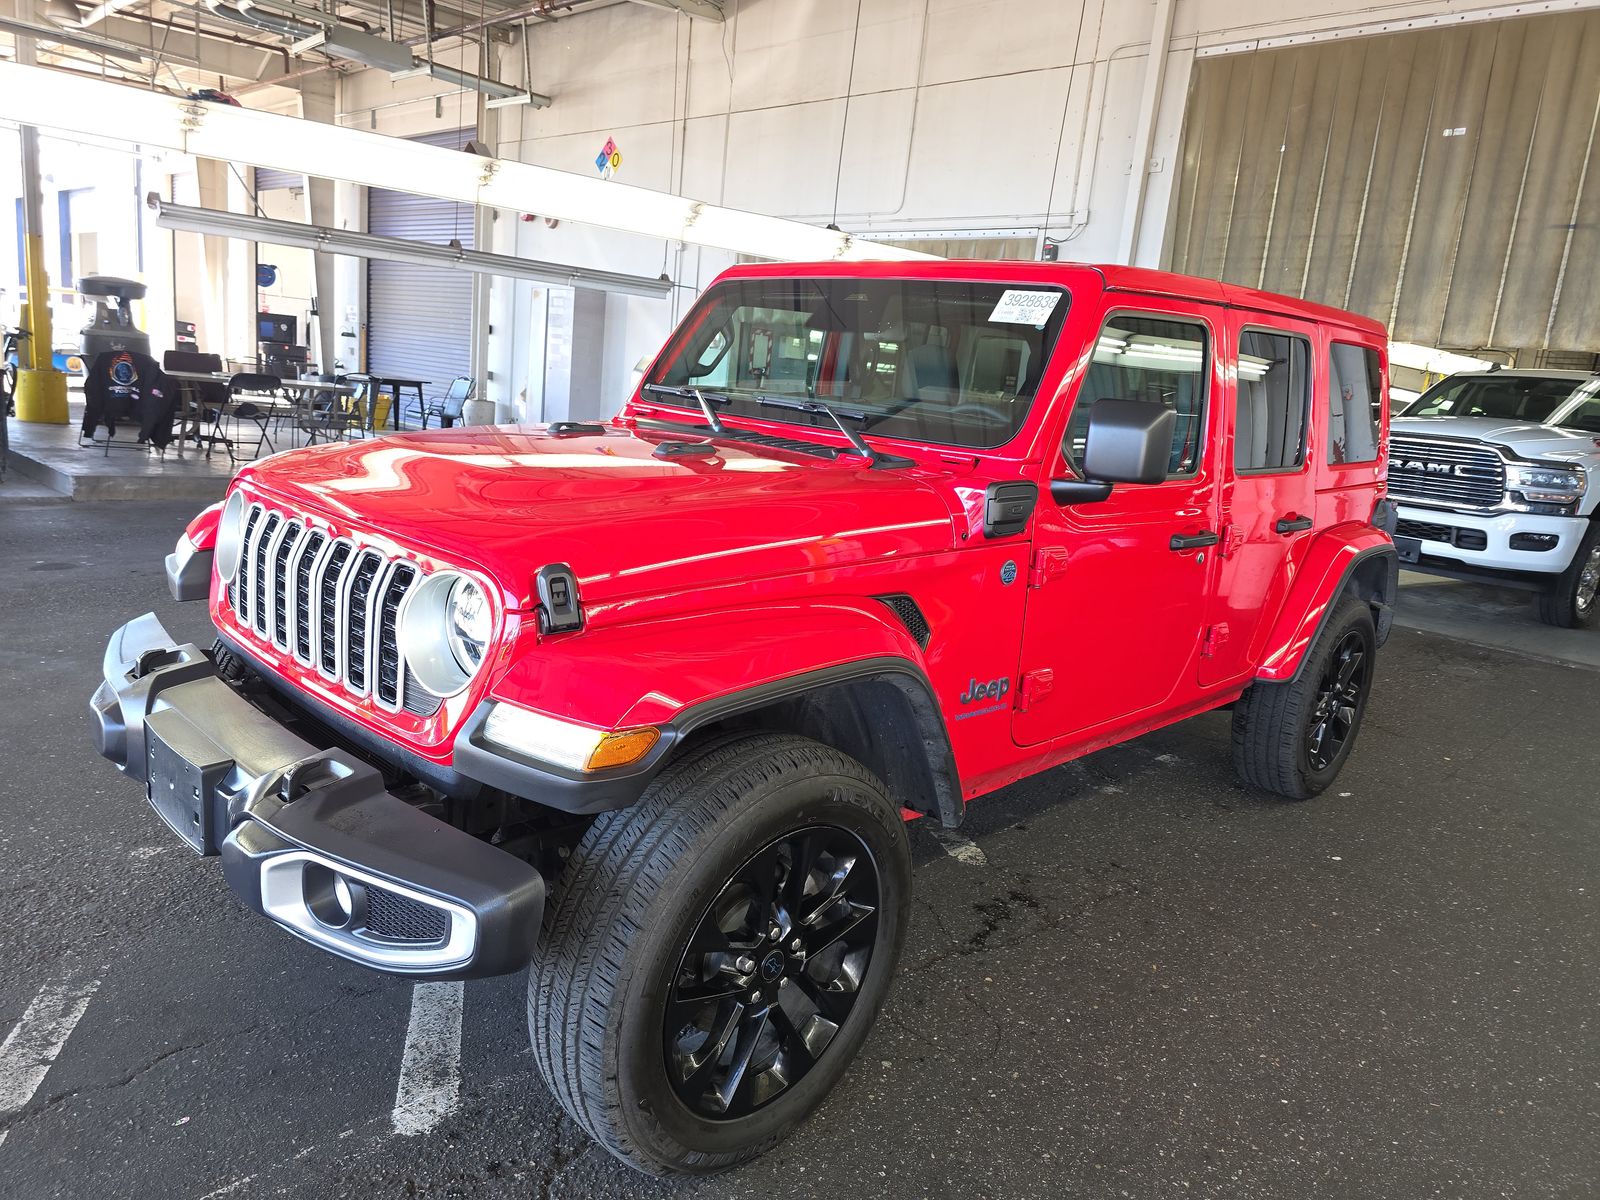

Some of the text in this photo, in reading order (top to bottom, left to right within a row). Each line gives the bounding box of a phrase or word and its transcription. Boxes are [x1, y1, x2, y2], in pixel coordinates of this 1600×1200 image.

[606, 141, 612, 155] 3
[599, 152, 606, 166] 2
[612, 153, 619, 167] 0
[1004, 294, 1059, 308] 3928838
[1388, 459, 1451, 473] RAM
[960, 677, 1010, 705] Jeep
[833, 787, 894, 831] NEXEN
